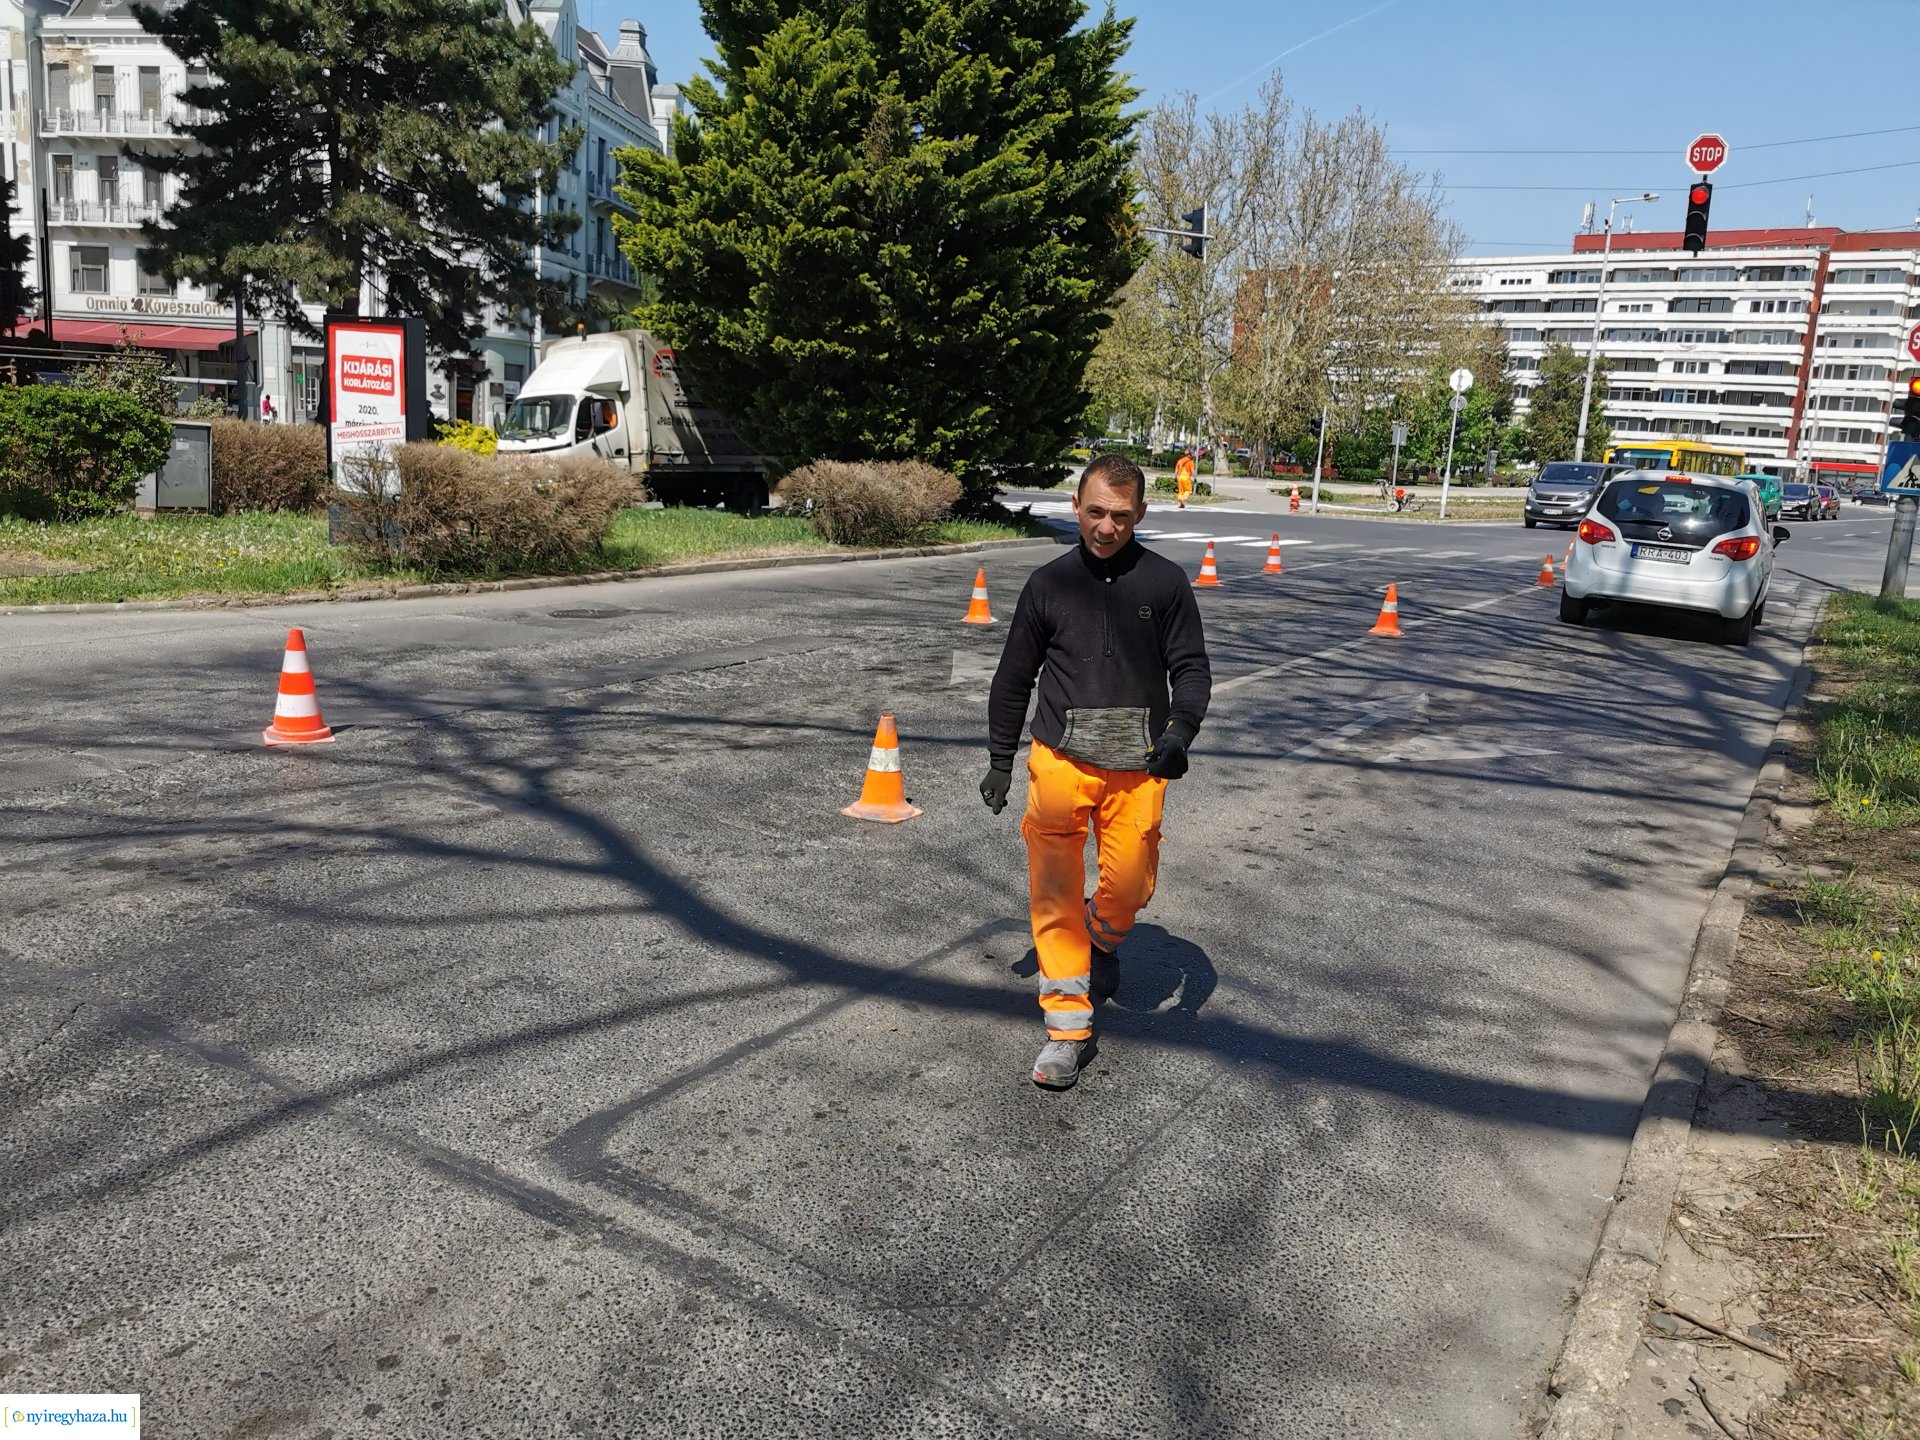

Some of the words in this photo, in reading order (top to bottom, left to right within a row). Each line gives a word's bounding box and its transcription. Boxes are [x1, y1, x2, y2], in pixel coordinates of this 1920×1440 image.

[1692, 147, 1722, 162] STOP
[343, 359, 392, 378] KIJÁRÁSI
[358, 404, 379, 416] 2020.
[337, 426, 401, 439] MEGHOSSZABBÍTVA
[1640, 547, 1688, 560] RRA-403
